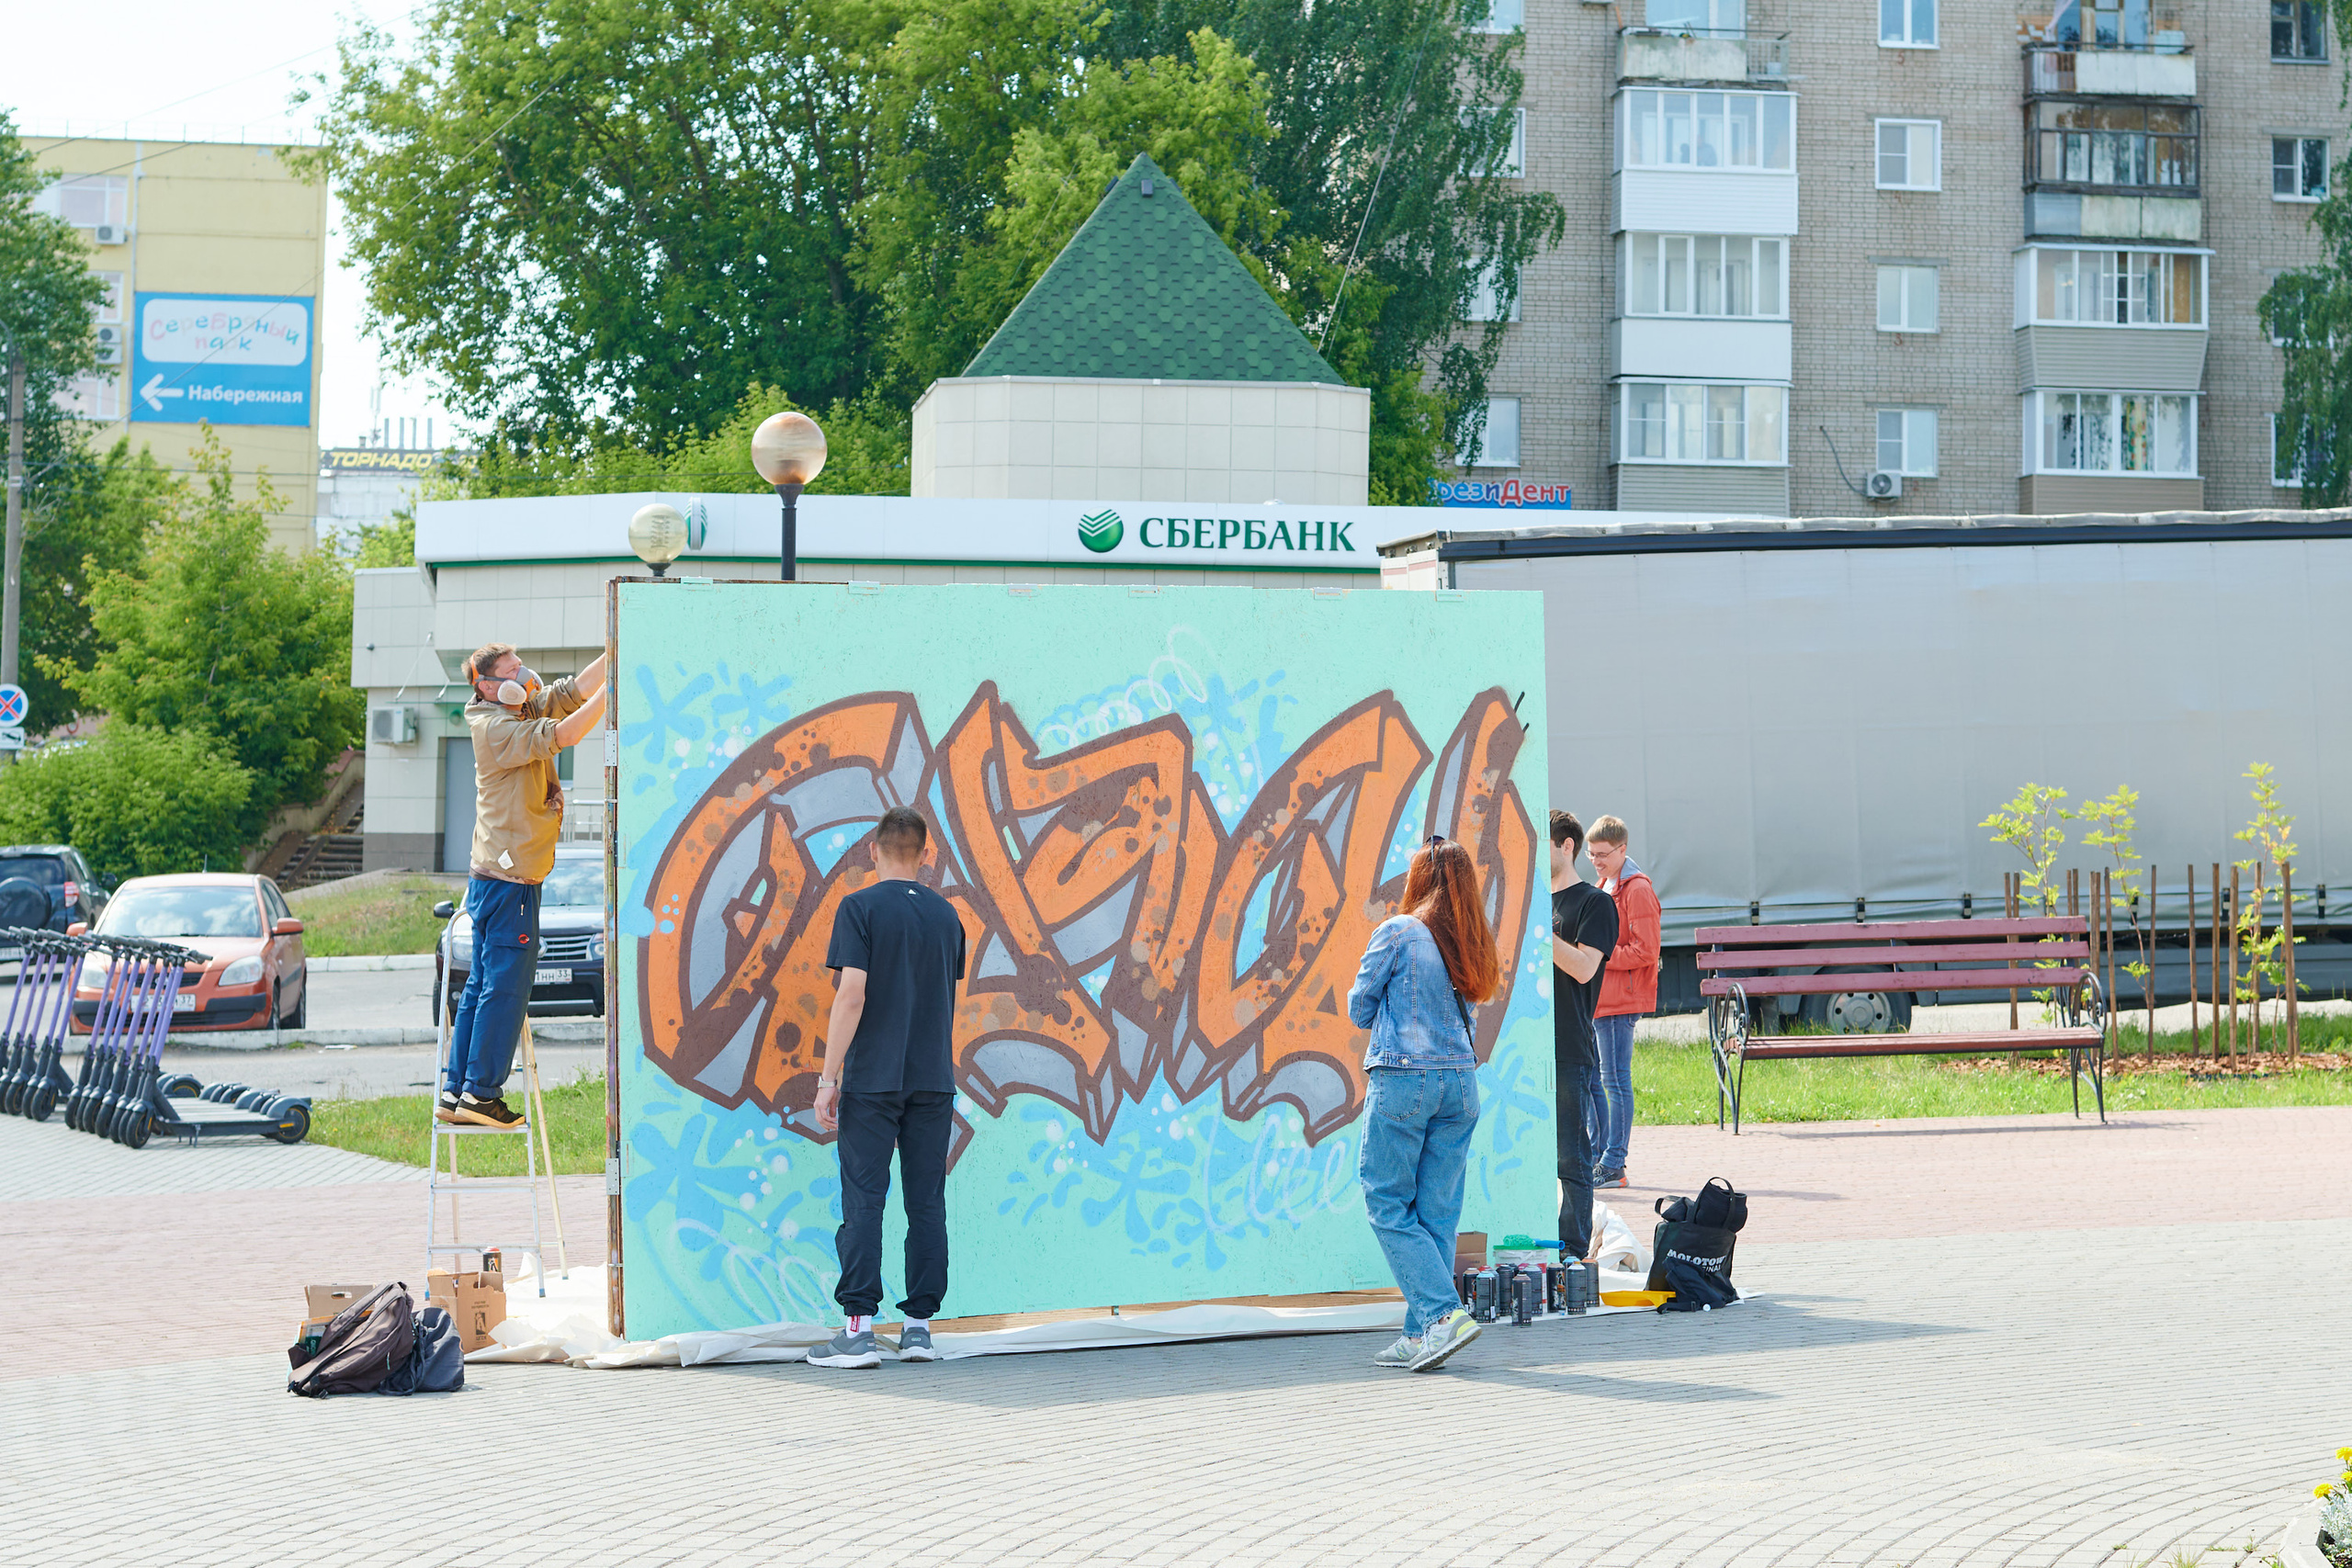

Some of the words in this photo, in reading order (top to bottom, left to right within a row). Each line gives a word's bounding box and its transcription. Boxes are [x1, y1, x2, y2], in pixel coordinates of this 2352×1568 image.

[188, 384, 303, 406] Набережная
[331, 451, 434, 471] ТОРНАДО
[1426, 477, 1570, 505] резиДент
[1138, 516, 1357, 552] СБЕРБАНК
[557, 969, 569, 978] 33
[1667, 1248, 1727, 1267] MOLOTOW
